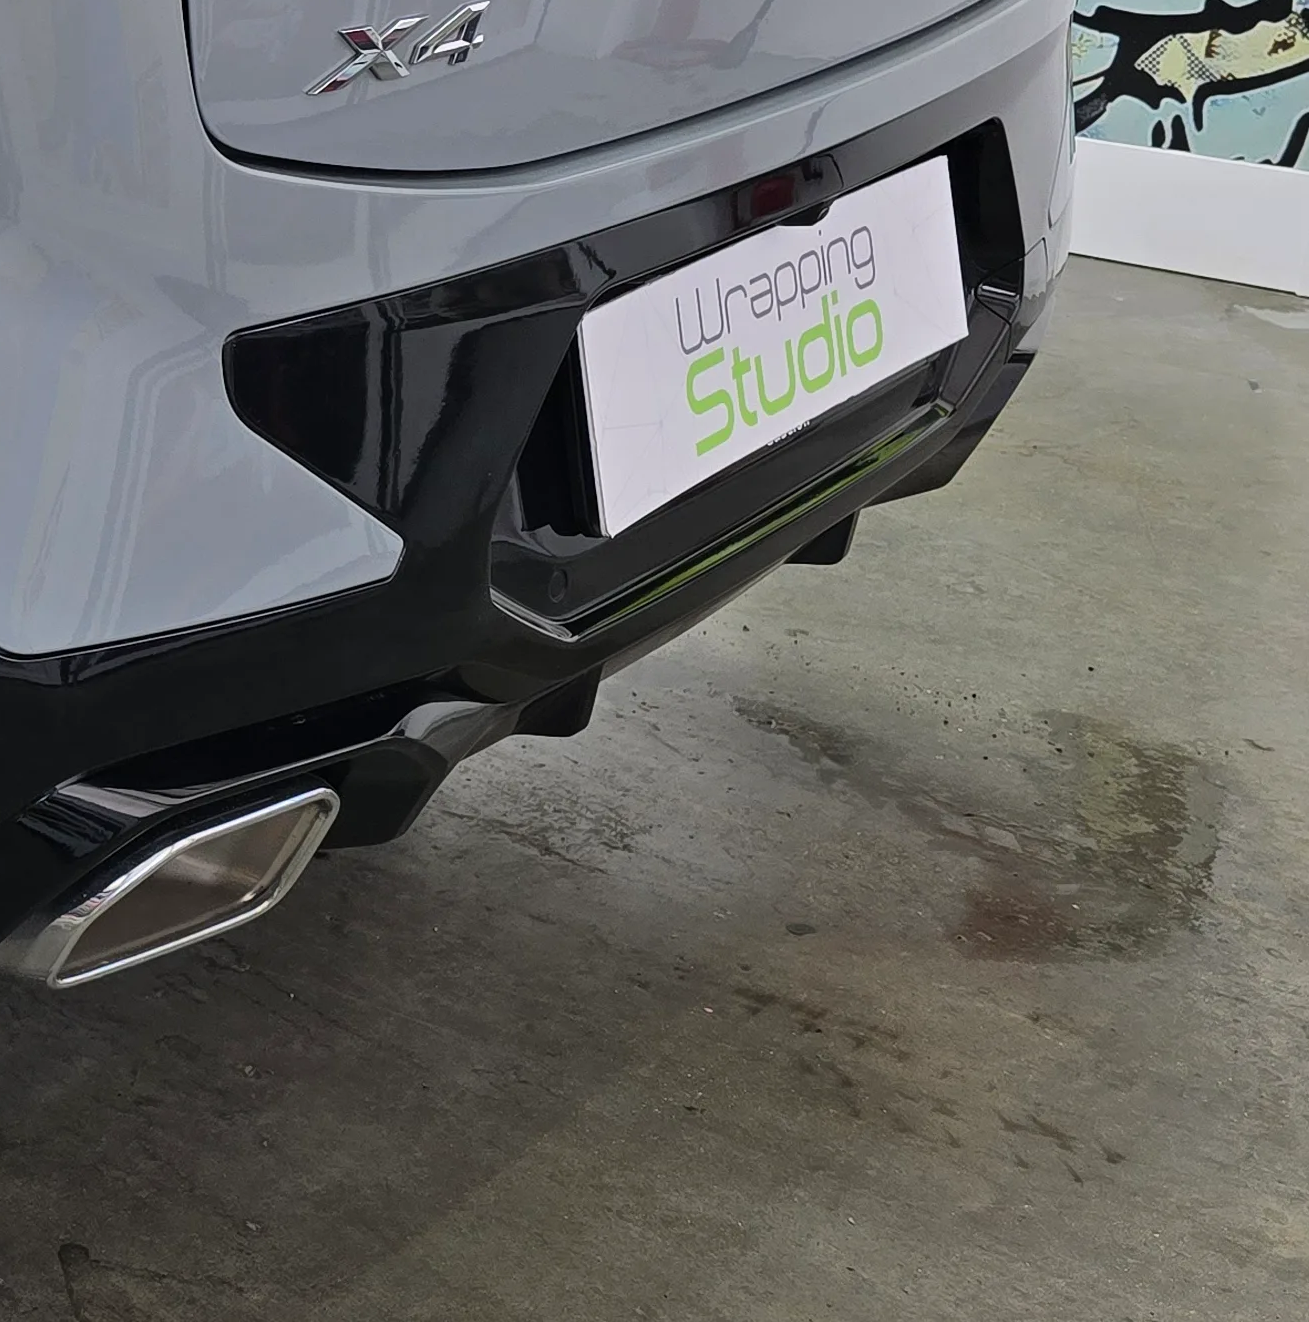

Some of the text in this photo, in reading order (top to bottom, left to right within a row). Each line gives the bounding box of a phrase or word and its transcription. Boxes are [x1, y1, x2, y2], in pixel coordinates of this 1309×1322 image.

[303, 0, 491, 96] X4
[675, 225, 876, 355] Wrapping
[685, 288, 884, 457] Studio
